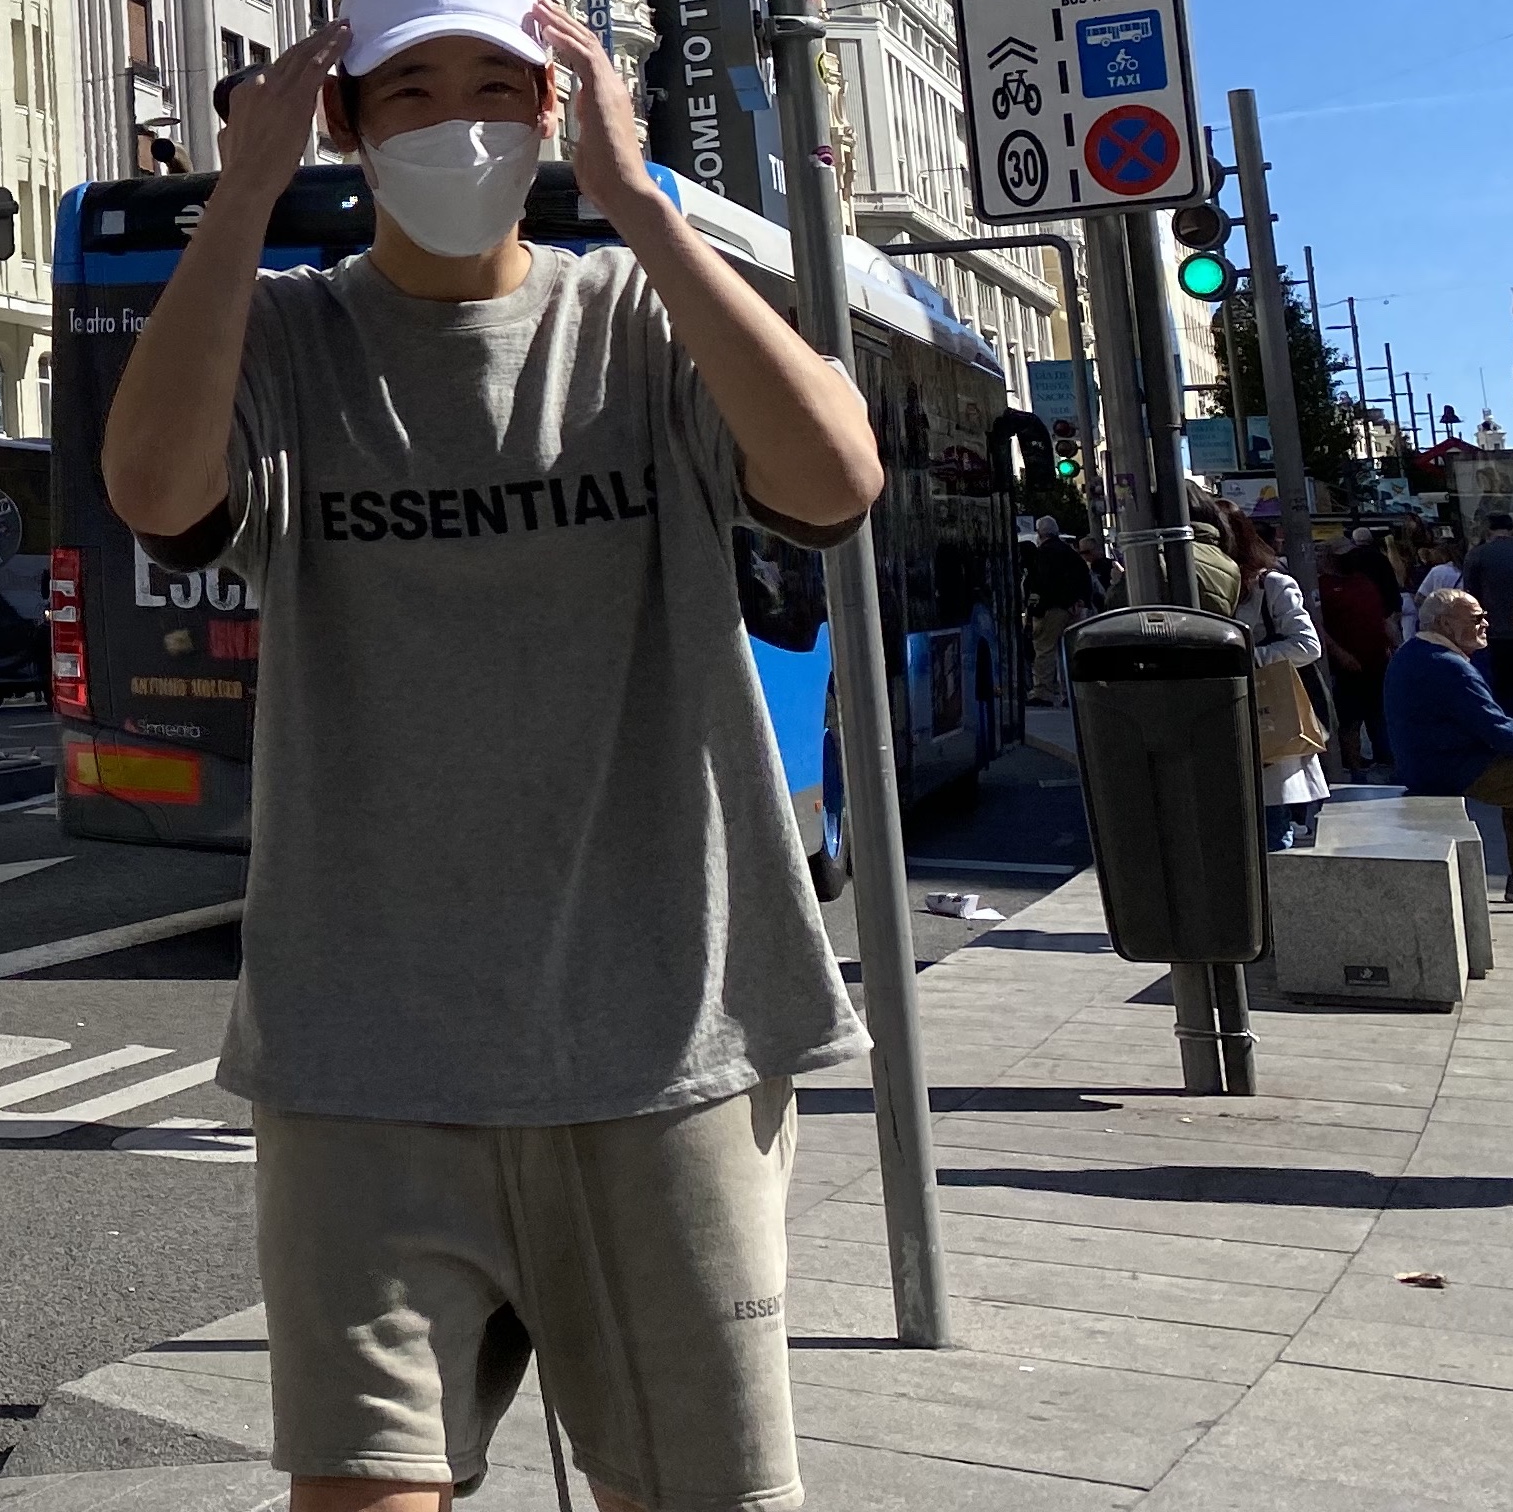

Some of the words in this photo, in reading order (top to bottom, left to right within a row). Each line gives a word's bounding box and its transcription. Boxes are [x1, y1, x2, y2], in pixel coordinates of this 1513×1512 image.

[682, 36, 714, 86] TO
[1107, 74, 1141, 88] TAXI
[1008, 149, 1038, 188] 30
